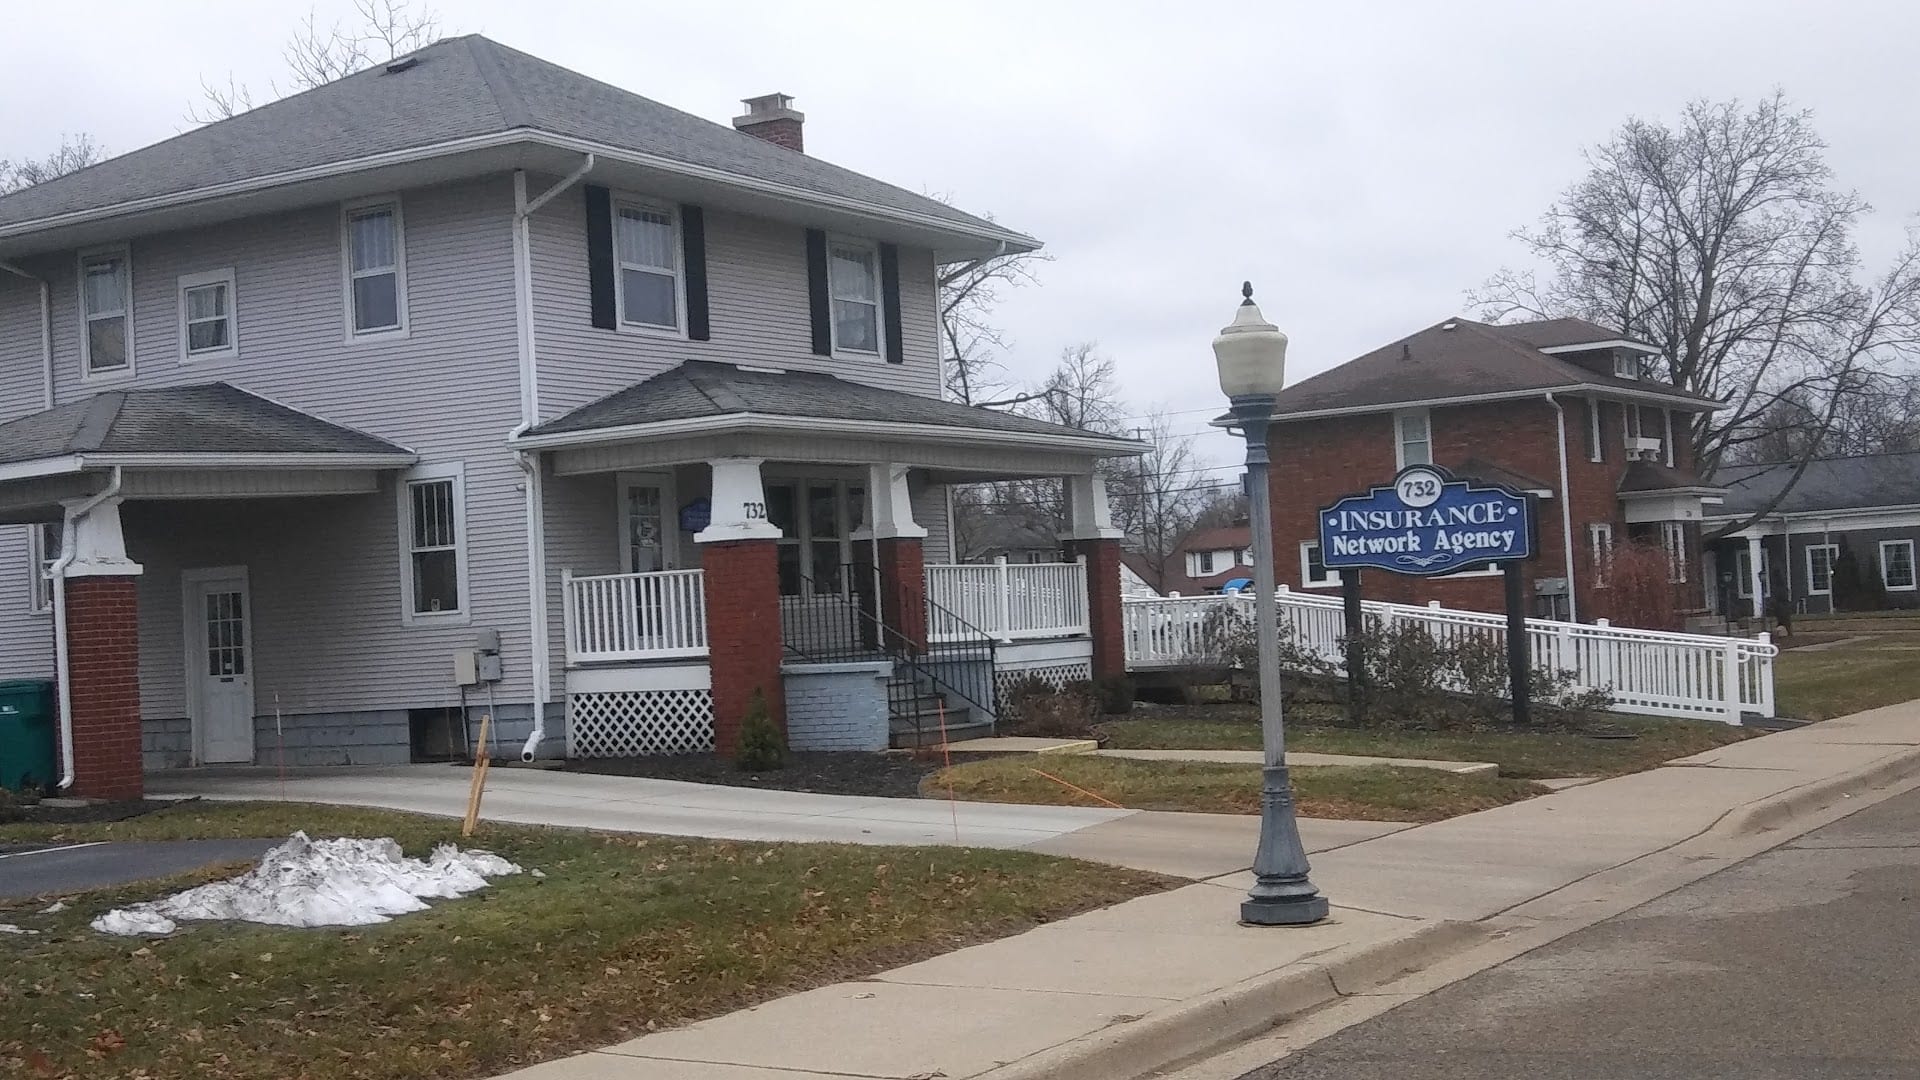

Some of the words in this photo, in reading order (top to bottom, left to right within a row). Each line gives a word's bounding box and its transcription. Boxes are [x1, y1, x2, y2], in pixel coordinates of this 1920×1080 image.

[1404, 480, 1436, 497] 732
[743, 502, 765, 519] 732
[1340, 501, 1505, 532] INSURANCE
[1332, 530, 1421, 556] Network
[1435, 528, 1515, 554] Agency
